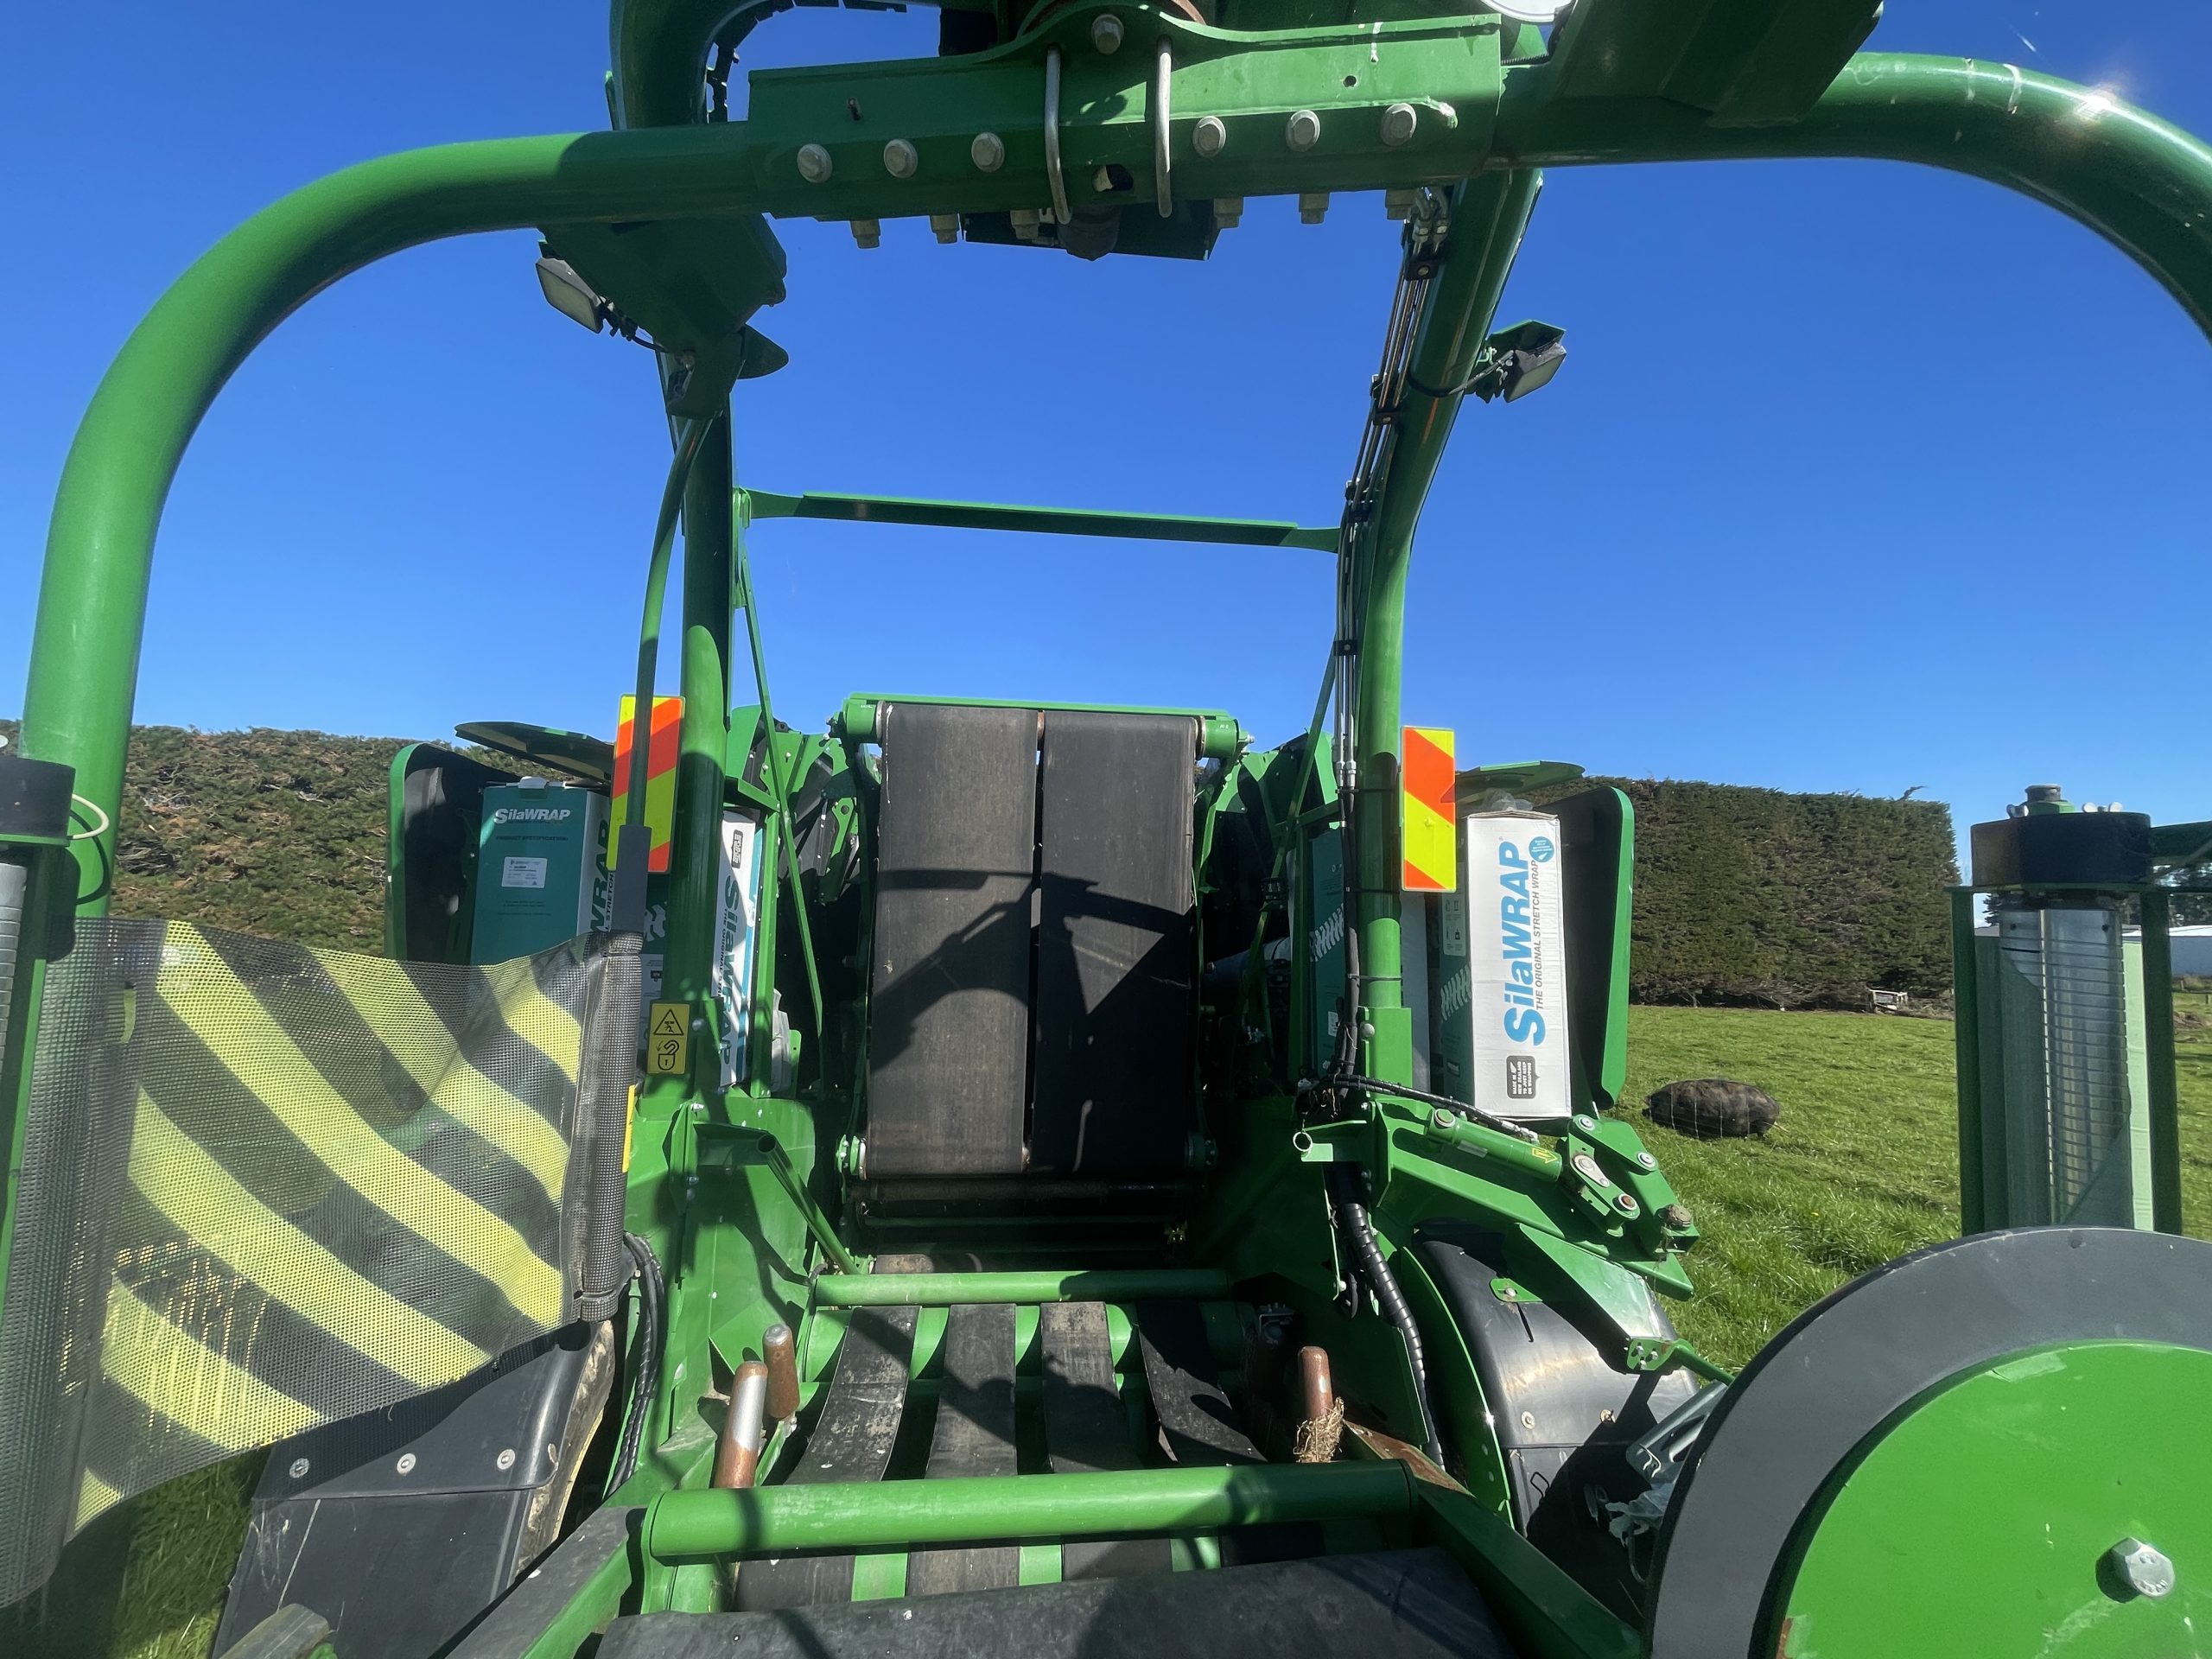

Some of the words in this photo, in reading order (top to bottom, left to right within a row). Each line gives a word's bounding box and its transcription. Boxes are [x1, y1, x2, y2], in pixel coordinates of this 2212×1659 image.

[493, 809, 571, 824] SilaWRAP
[1530, 860, 1539, 888] WRAP
[1532, 892, 1541, 937] STRETCH
[1499, 842, 1546, 1046] SilaWRAP
[1534, 940, 1542, 988] ORIGINAL
